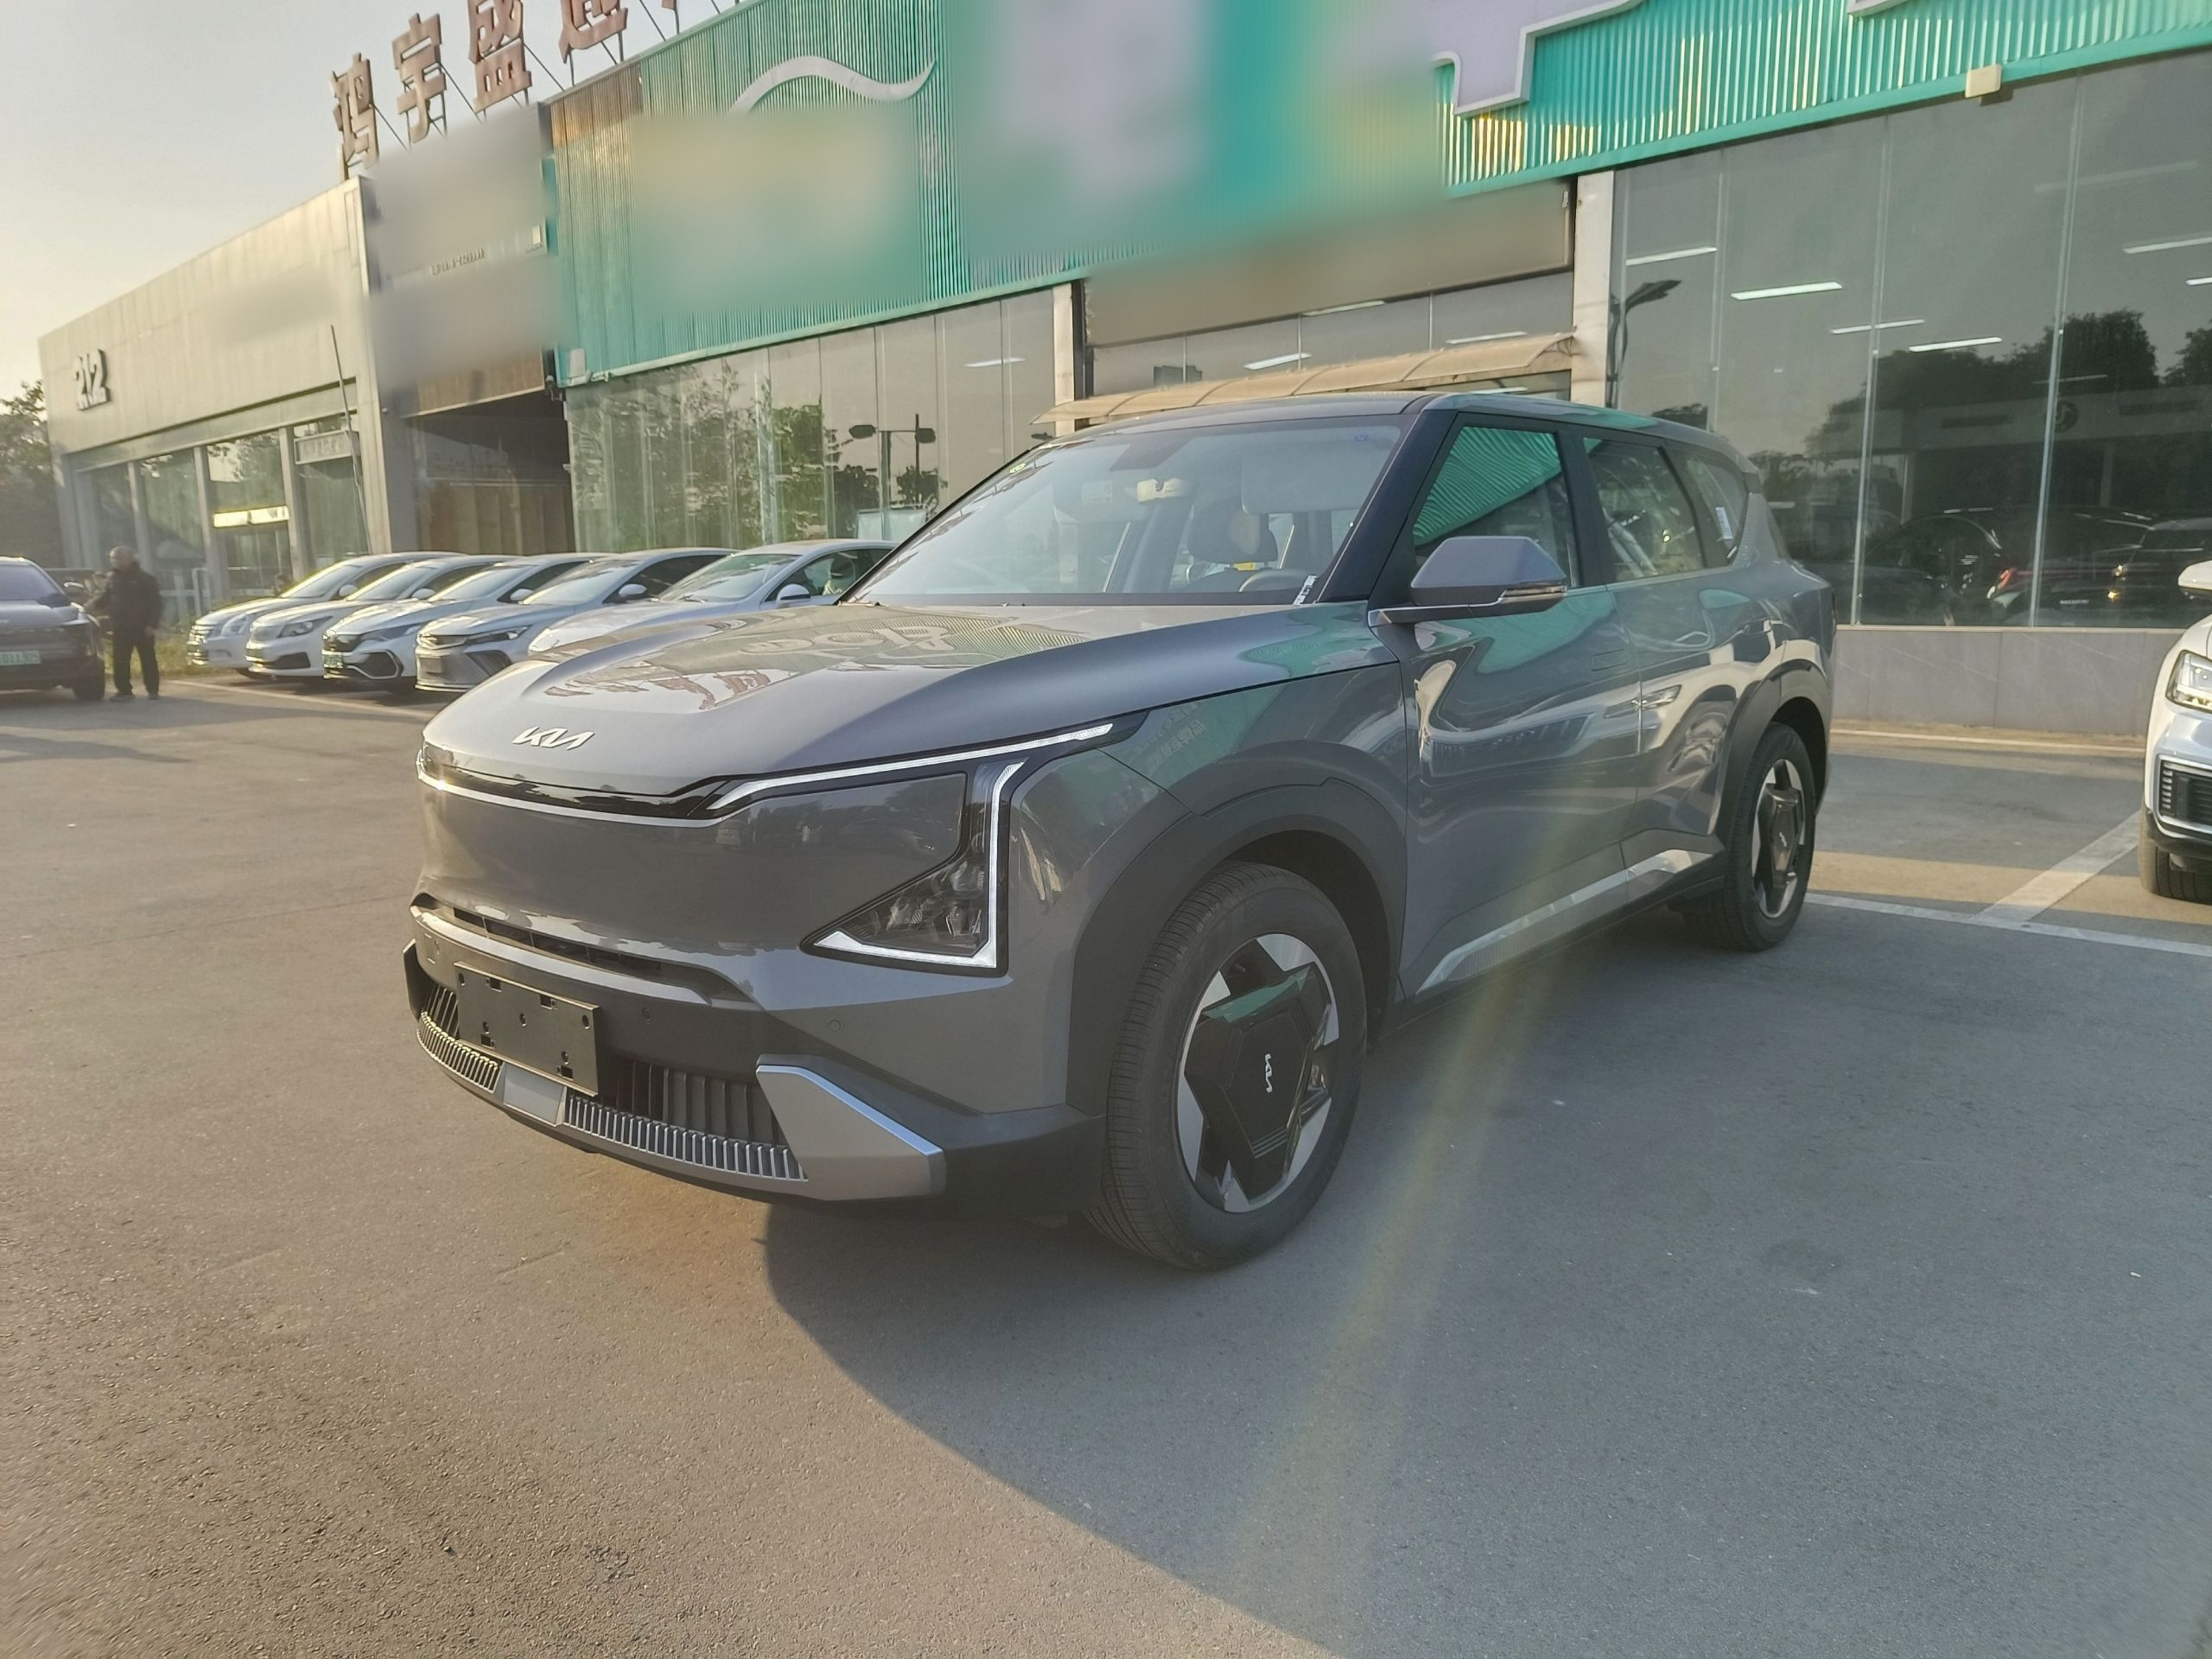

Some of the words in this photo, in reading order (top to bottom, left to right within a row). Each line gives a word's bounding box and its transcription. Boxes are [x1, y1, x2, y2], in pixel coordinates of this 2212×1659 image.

[327, 0, 677, 180] 鸿宇盛
[73, 348, 111, 410] 212
[512, 726, 595, 751] KIA
